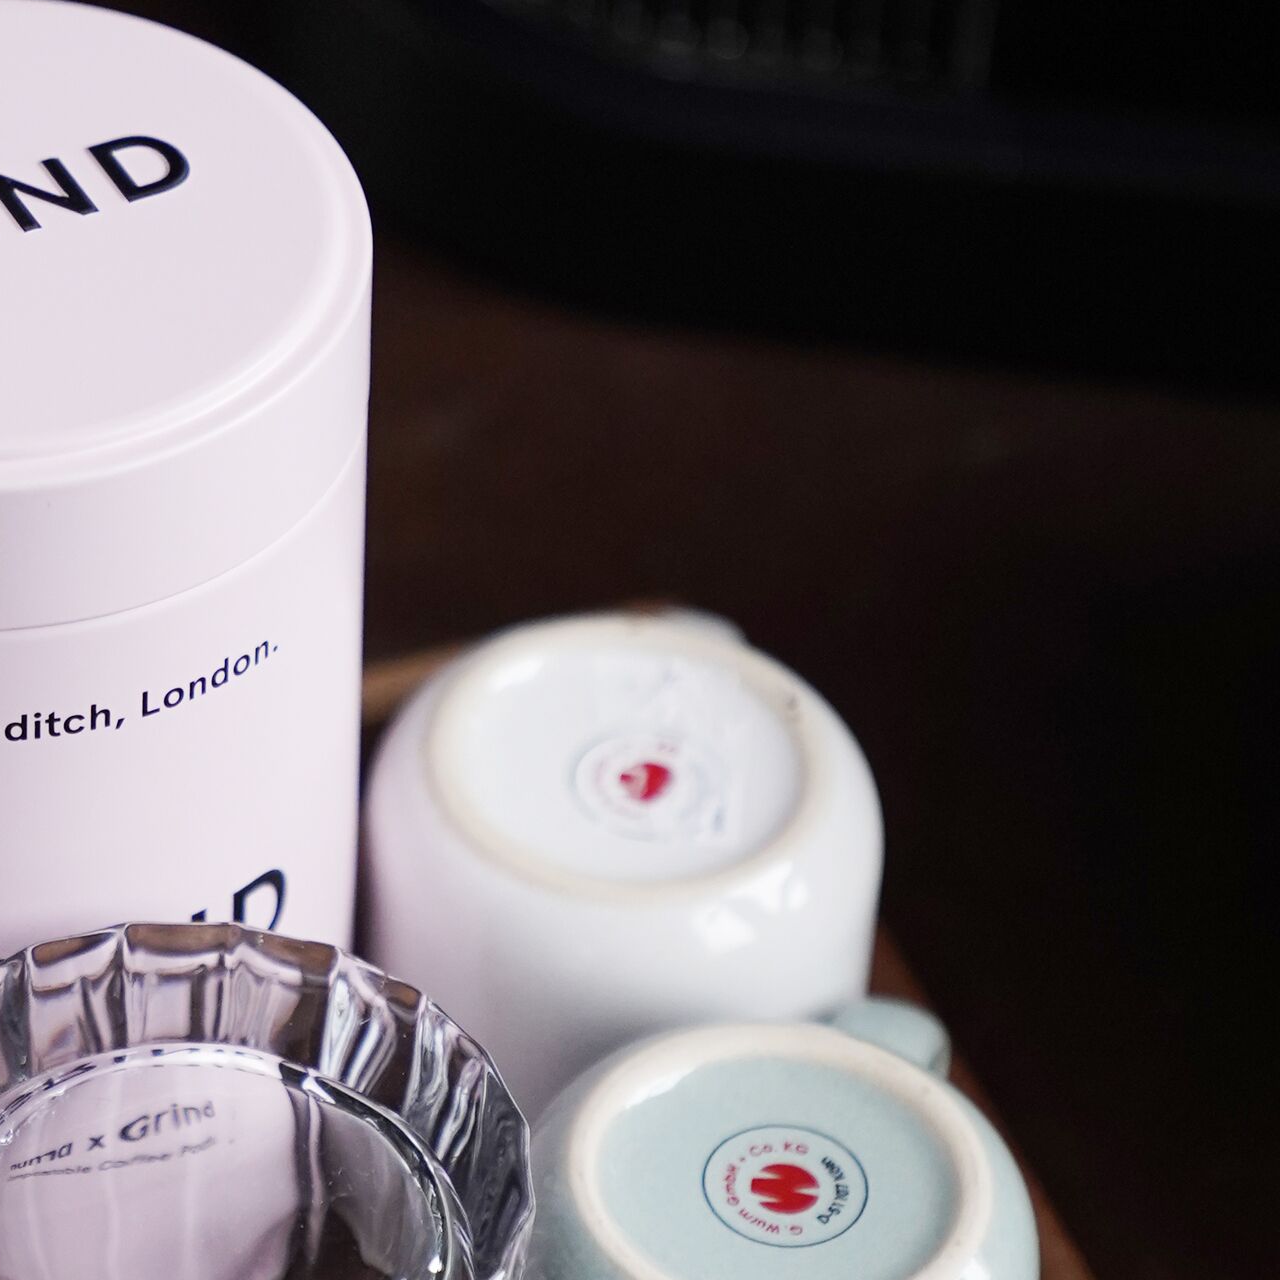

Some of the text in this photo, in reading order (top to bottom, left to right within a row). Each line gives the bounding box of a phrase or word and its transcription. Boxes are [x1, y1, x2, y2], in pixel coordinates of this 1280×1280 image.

[141, 639, 279, 718] London.
[87, 1135, 105, 1151] x
[118, 1100, 216, 1141] Grind
[738, 1208, 781, 1234] Wurm
